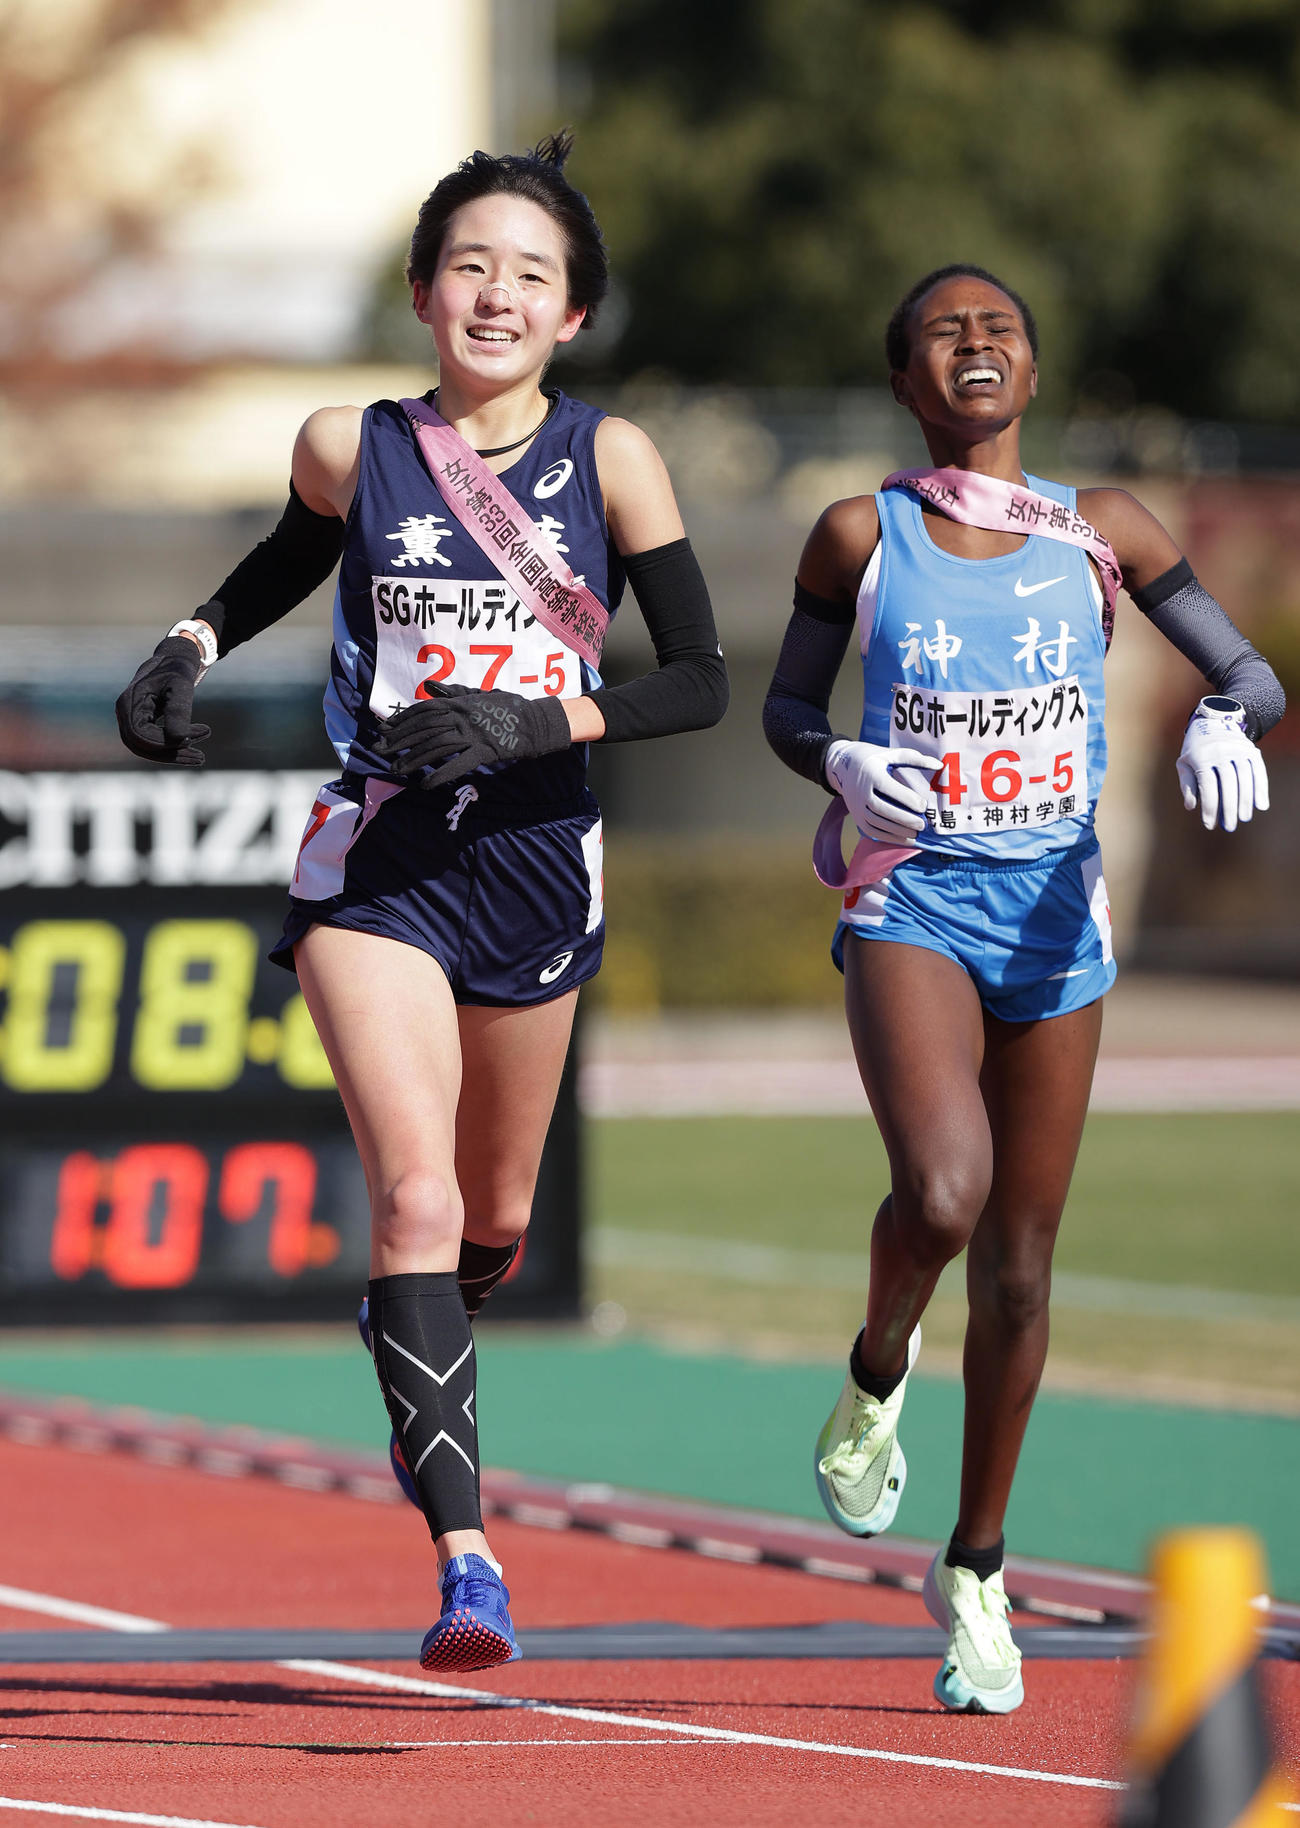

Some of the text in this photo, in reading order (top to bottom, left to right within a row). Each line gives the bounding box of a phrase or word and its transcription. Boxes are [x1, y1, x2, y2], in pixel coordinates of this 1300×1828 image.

[415, 644, 565, 700] 27-5
[470, 711, 519, 751] Move
[894, 685, 1085, 738] SGホールディングス
[930, 750, 1073, 805] 46-5
